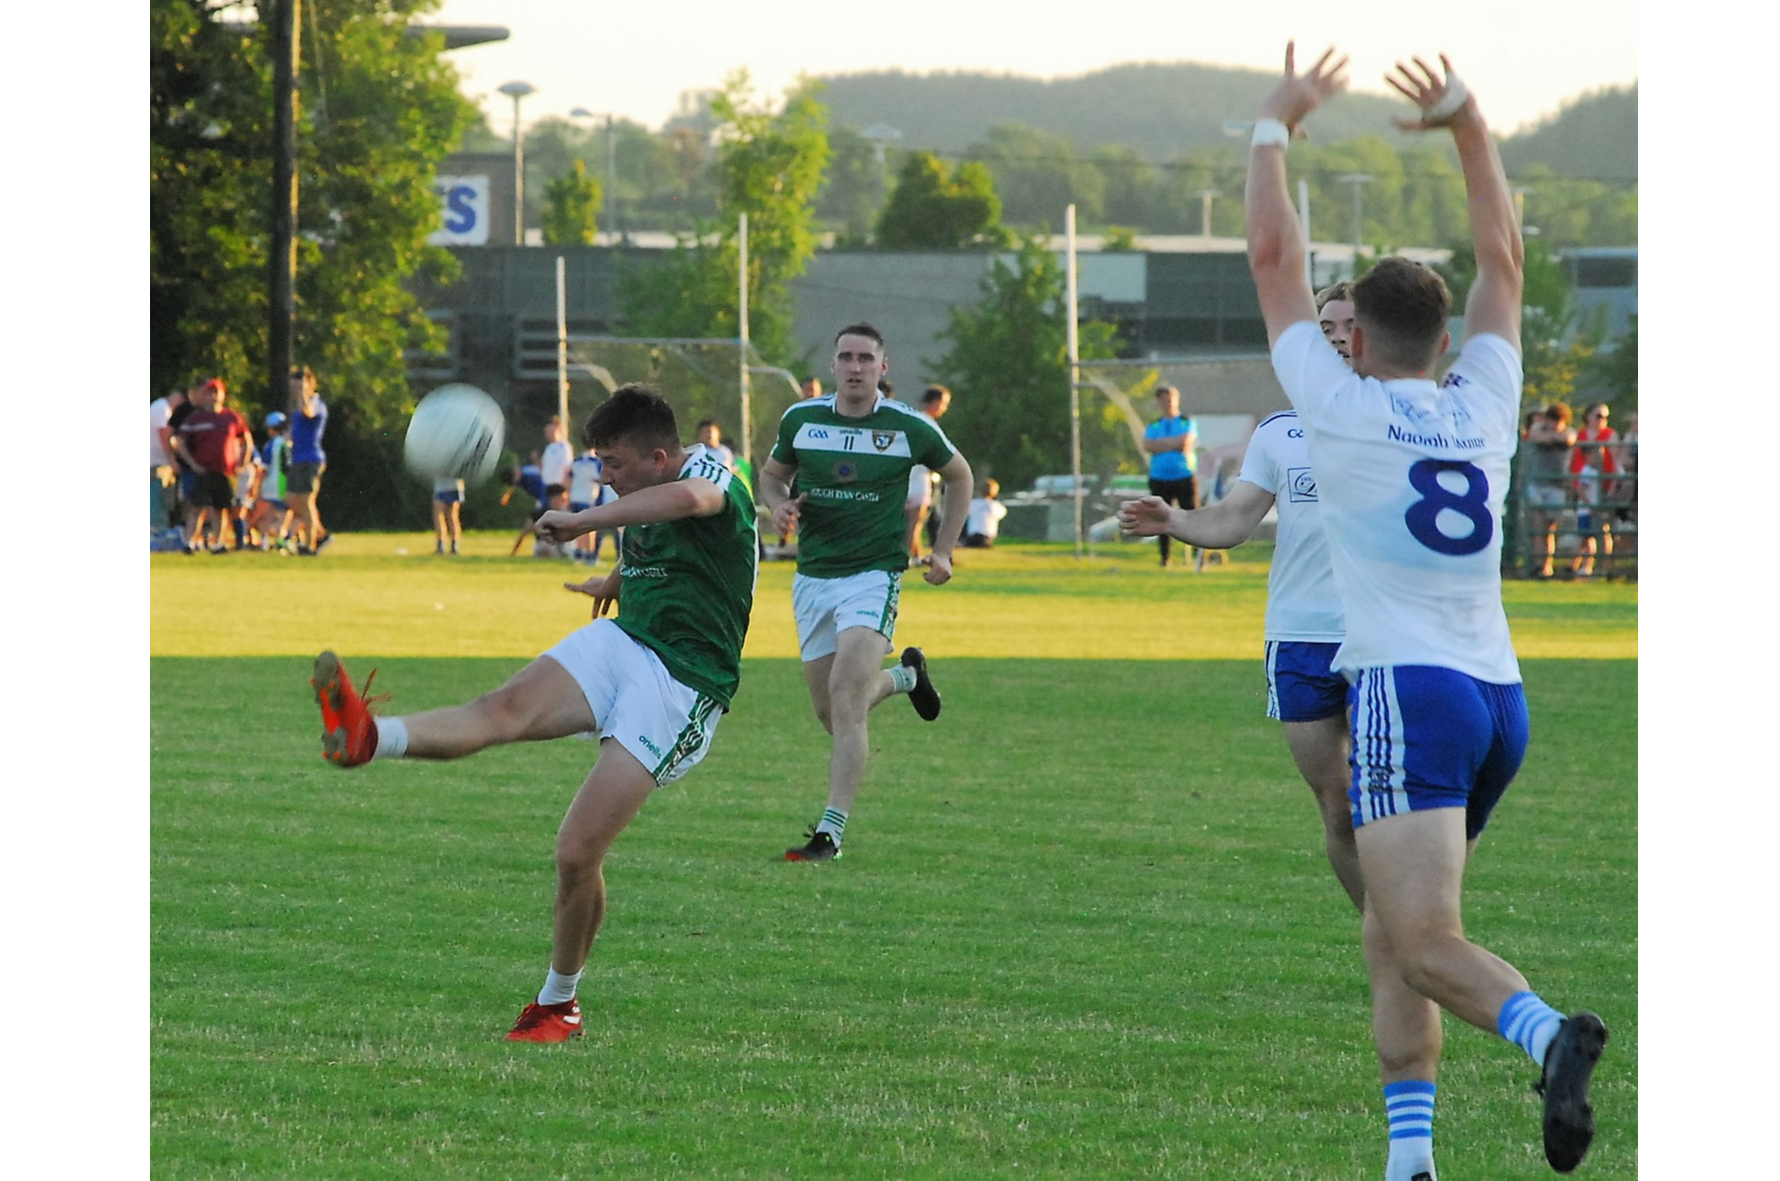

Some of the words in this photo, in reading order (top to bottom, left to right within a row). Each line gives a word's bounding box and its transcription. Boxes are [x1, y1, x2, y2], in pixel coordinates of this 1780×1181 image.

[844, 436, 854, 451] 11
[1388, 423, 1449, 448] Naomh
[1405, 458, 1493, 557] 8
